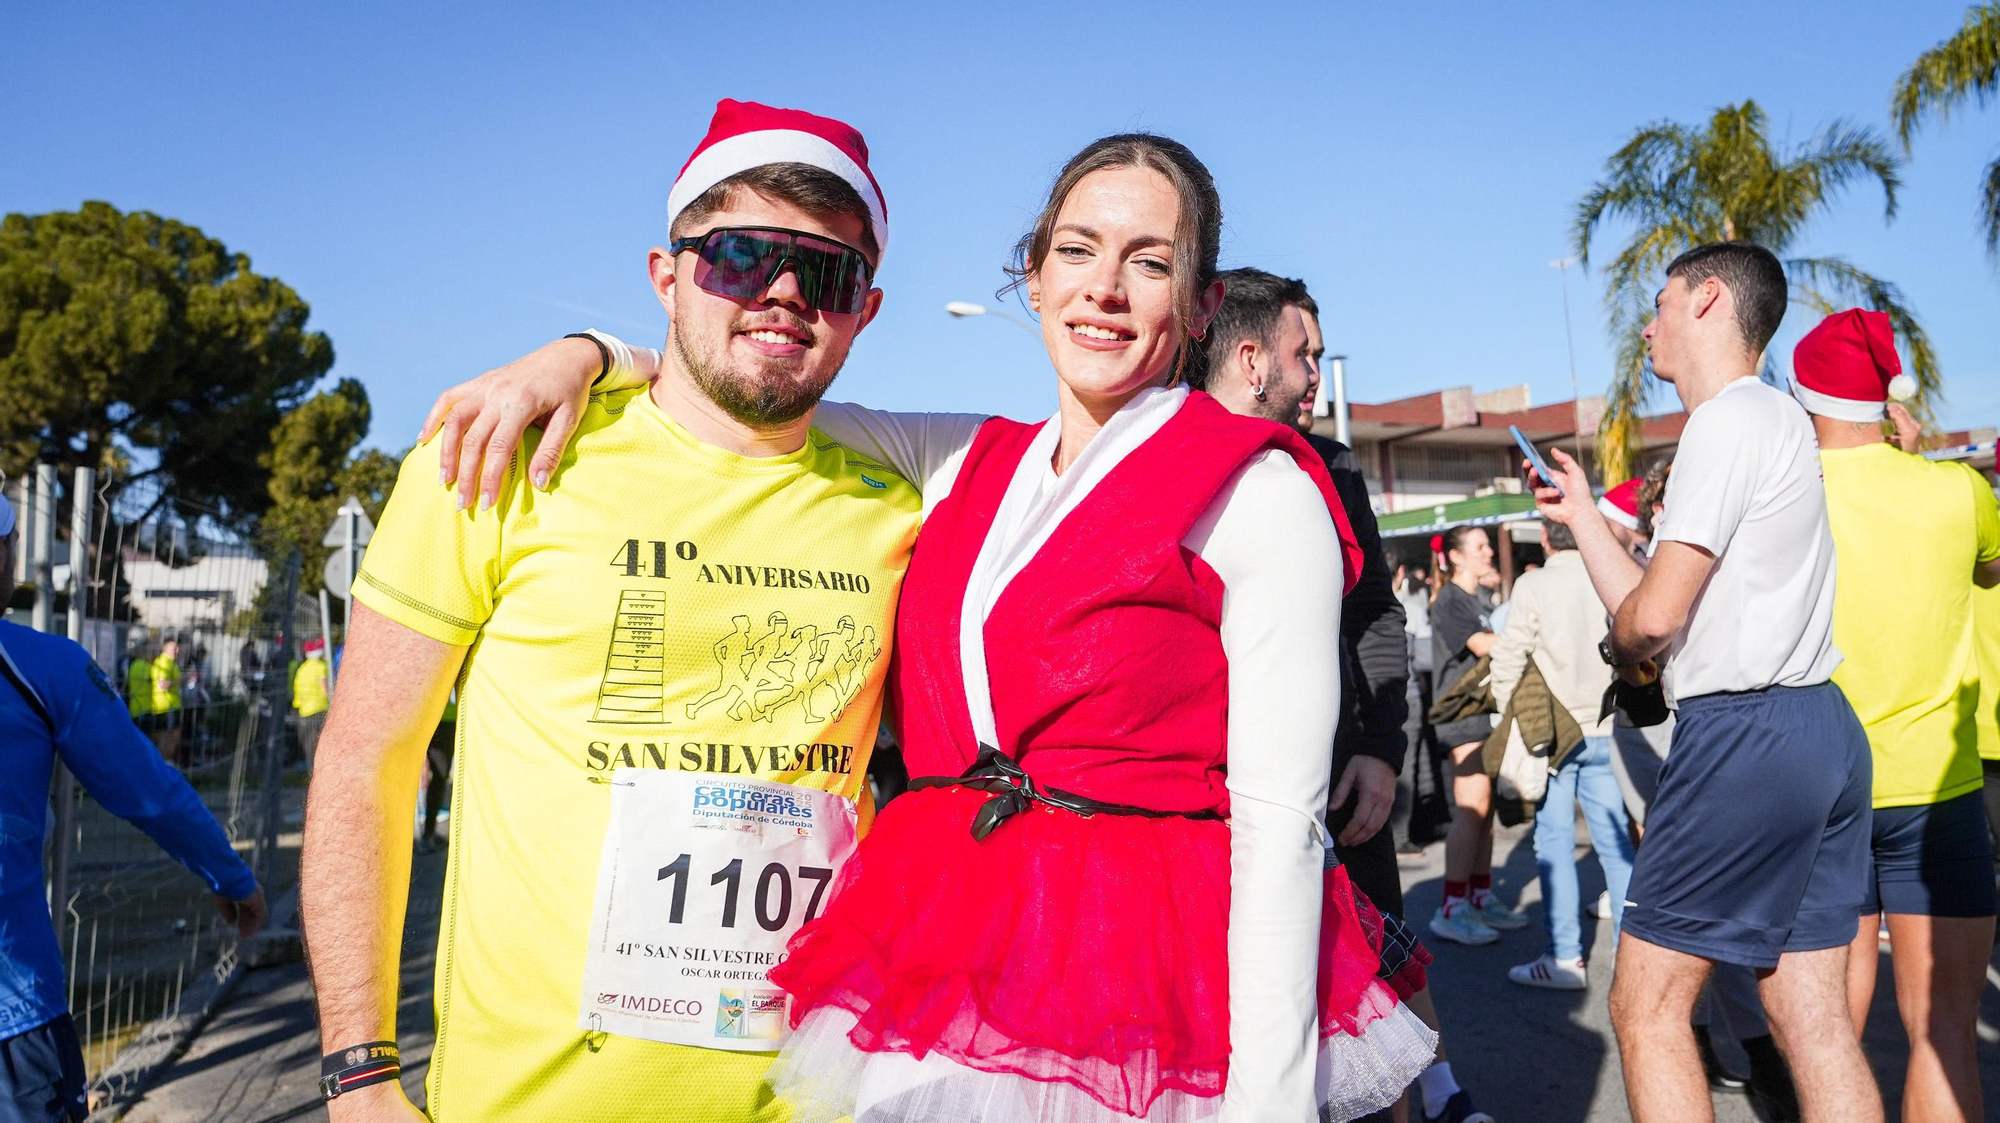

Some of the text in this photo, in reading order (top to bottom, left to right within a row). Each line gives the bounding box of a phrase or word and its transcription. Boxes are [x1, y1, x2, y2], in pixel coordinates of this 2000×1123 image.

[696, 564, 871, 594] ANIVERSARIO
[586, 741, 854, 775] SAN SILVESTRE
[694, 786, 795, 808] carreras
[696, 779, 795, 797] CIRCUITO PROVINCIAL
[693, 795, 813, 819] populares
[692, 809, 813, 829] Diputación de Córdoba
[657, 853, 833, 932] 1107
[644, 943, 680, 959] SAN
[683, 947, 775, 966] SILVESTRE
[681, 967, 770, 981] OSCAR ORTEGA
[621, 994, 702, 1016] IMDECO
[760, 1000, 785, 1008] PARQUE
